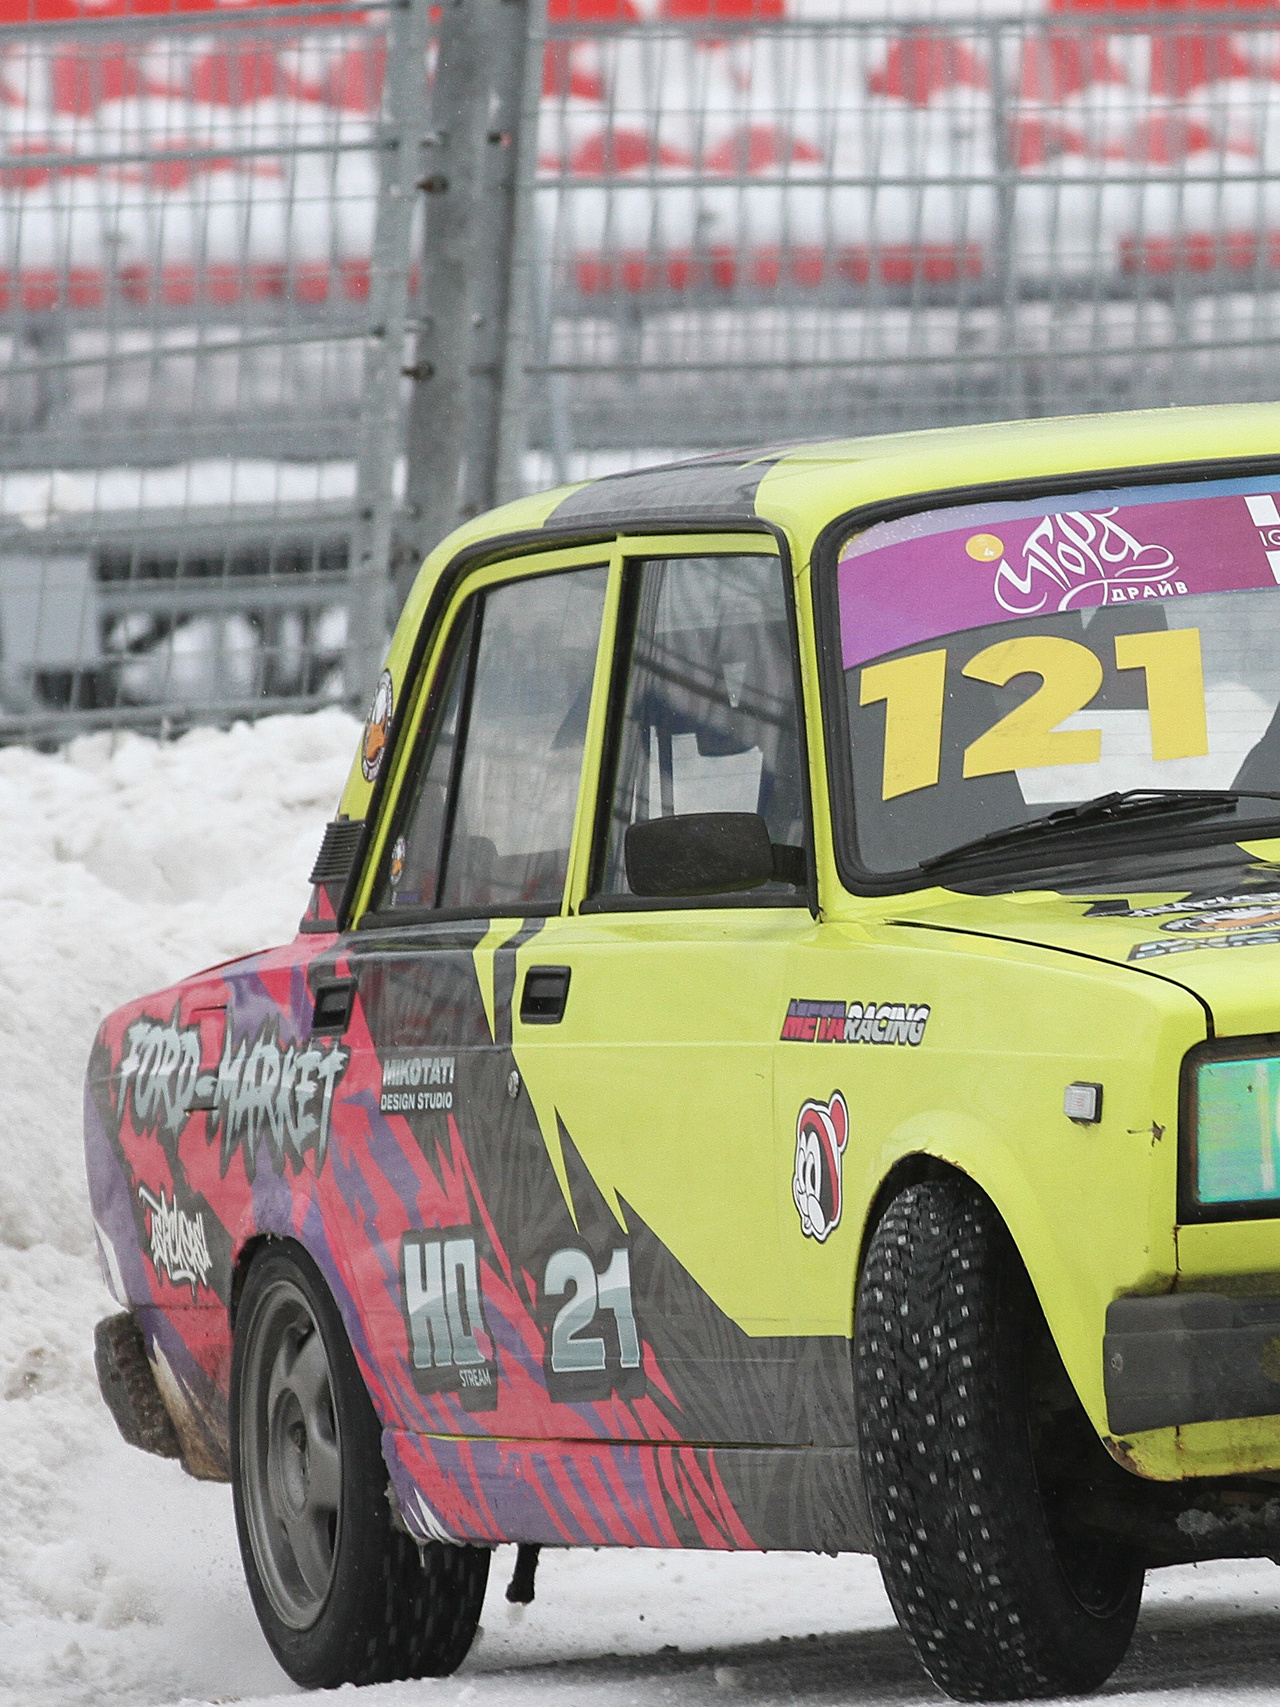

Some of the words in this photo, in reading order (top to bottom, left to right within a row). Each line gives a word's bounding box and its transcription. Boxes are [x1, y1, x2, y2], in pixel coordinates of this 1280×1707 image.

[1111, 580, 1188, 602] ДРАЙВ
[860, 628, 1209, 801] 121
[382, 1057, 456, 1086] MIKOTATI
[381, 1093, 416, 1111] DESIGN
[418, 1091, 453, 1110] STUDIO
[543, 1247, 640, 1374] 21
[459, 1367, 492, 1388] STREAM
